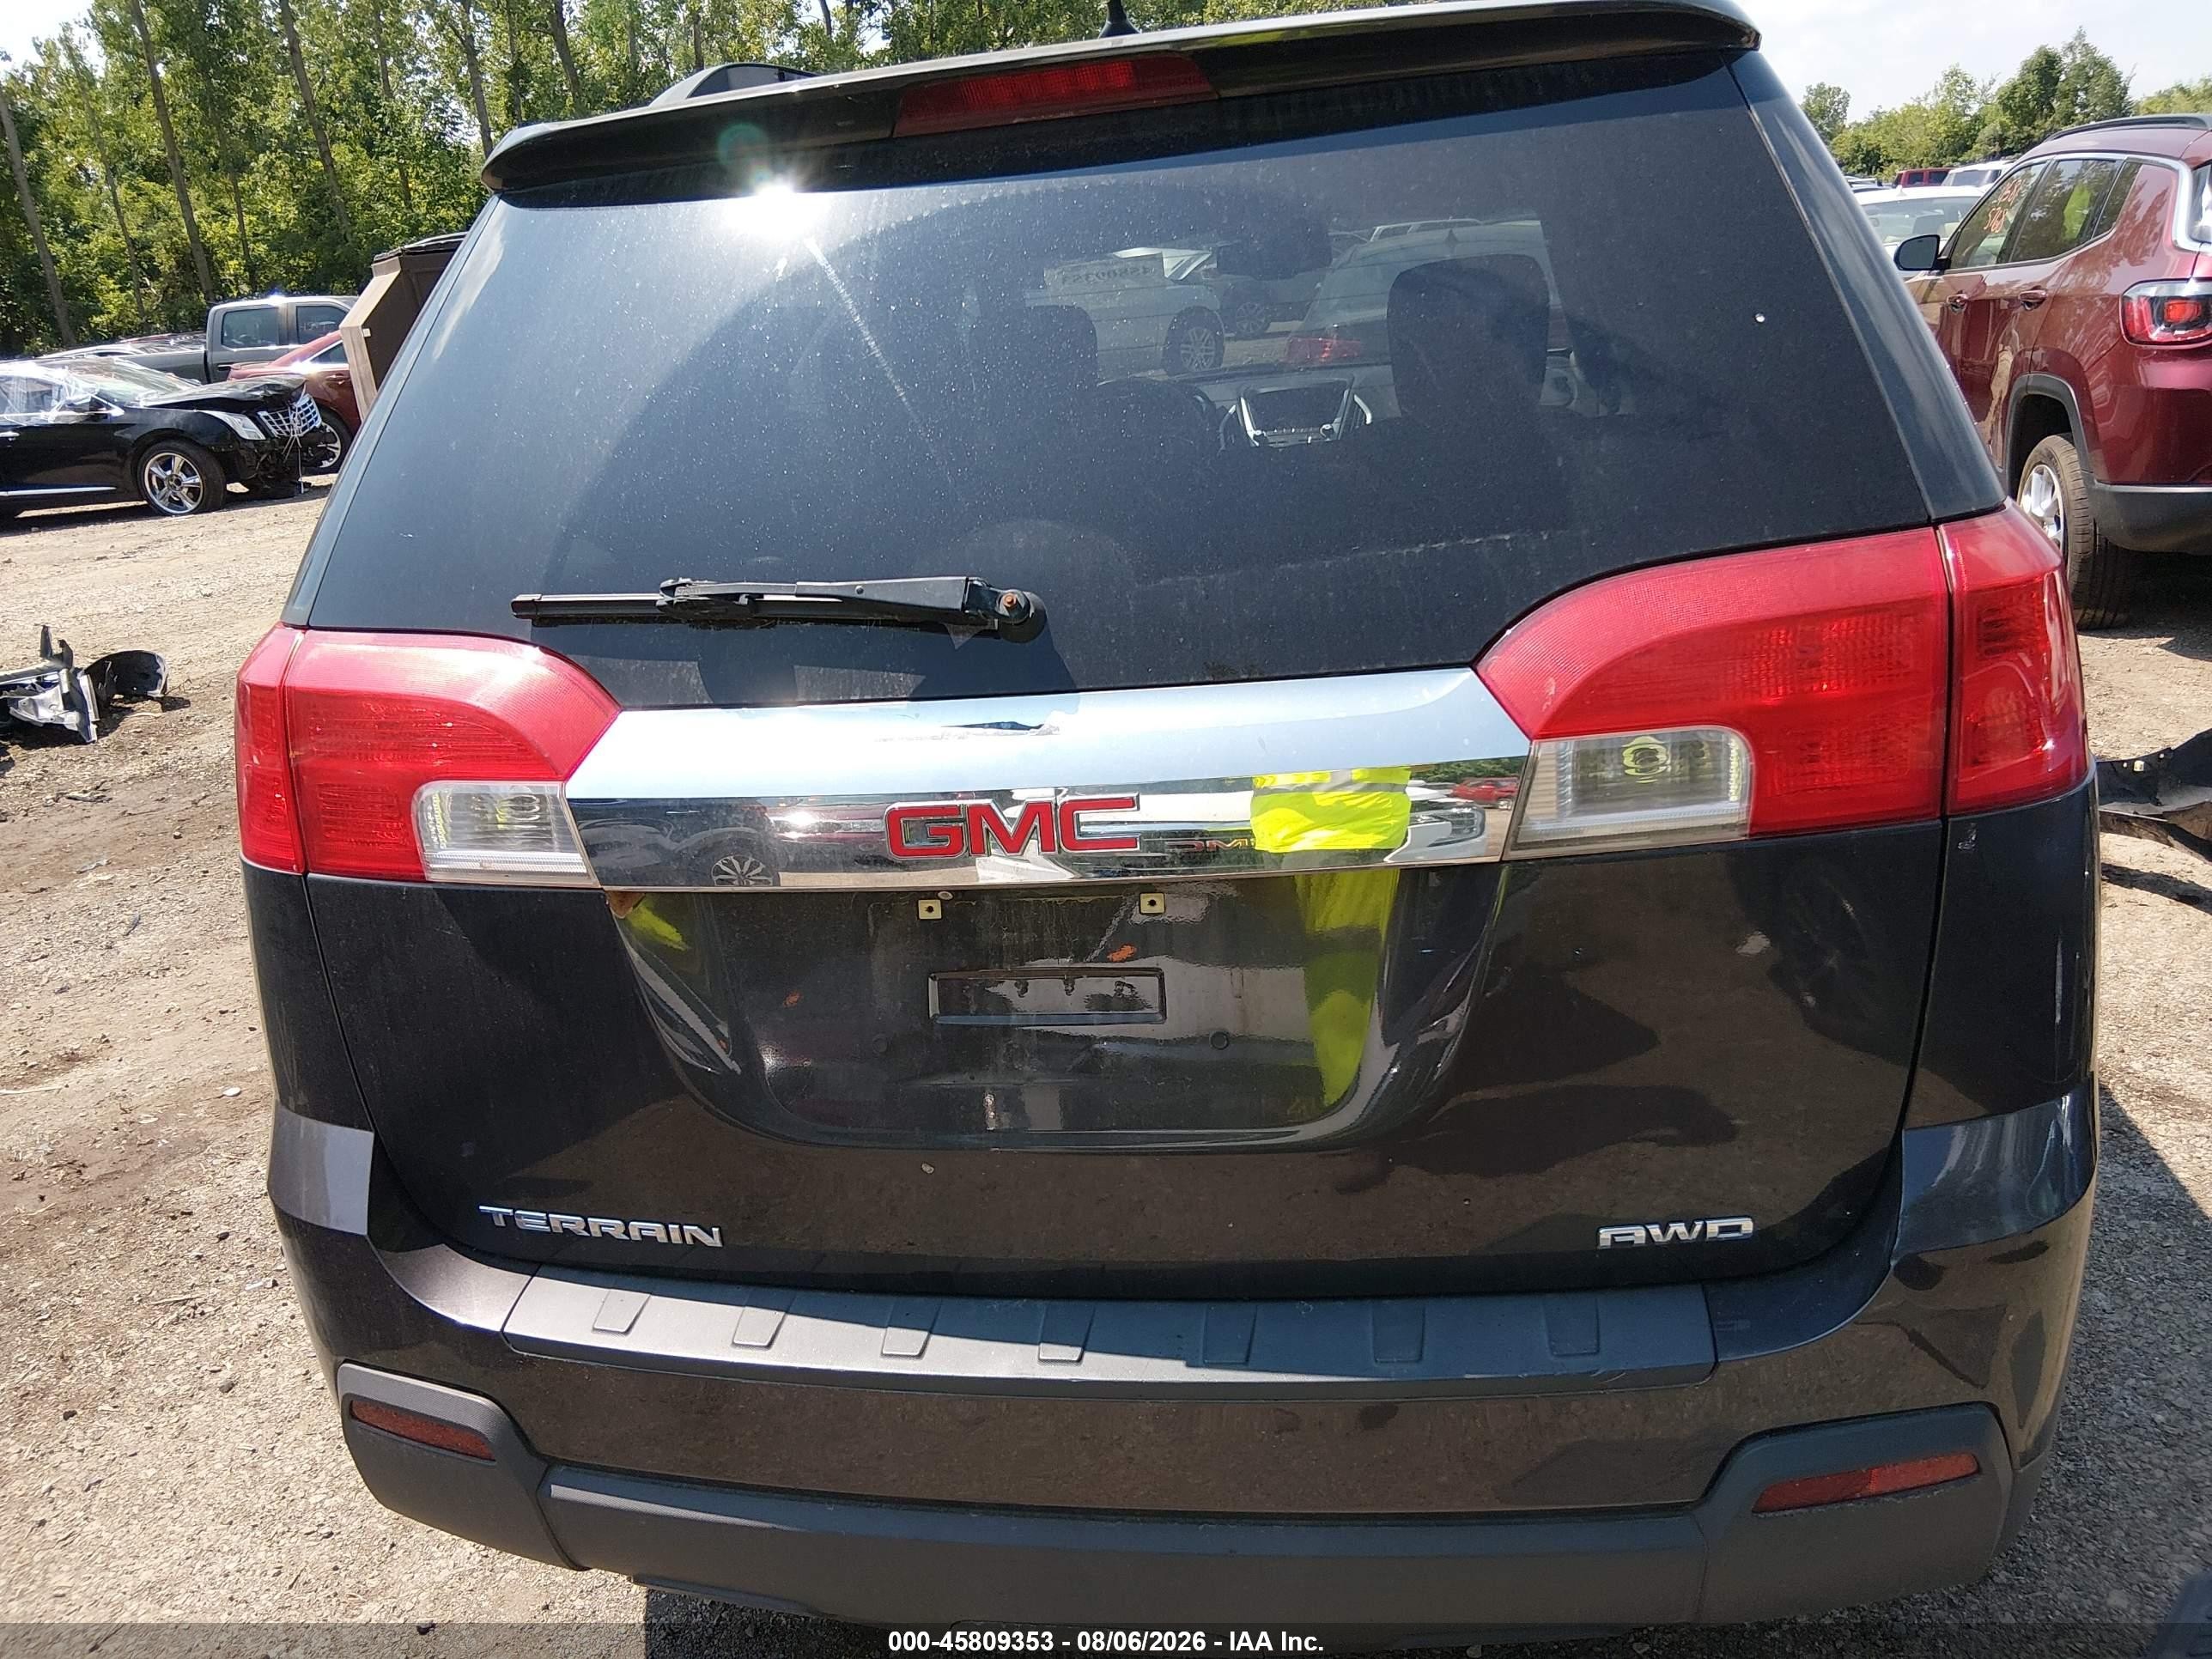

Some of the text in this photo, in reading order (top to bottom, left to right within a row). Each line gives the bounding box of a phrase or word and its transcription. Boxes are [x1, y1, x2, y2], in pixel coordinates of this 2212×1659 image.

[884, 792, 1140, 860] GMC
[478, 1205, 724, 1248] TERRAIN
[1598, 1215, 1753, 1249] AWD
